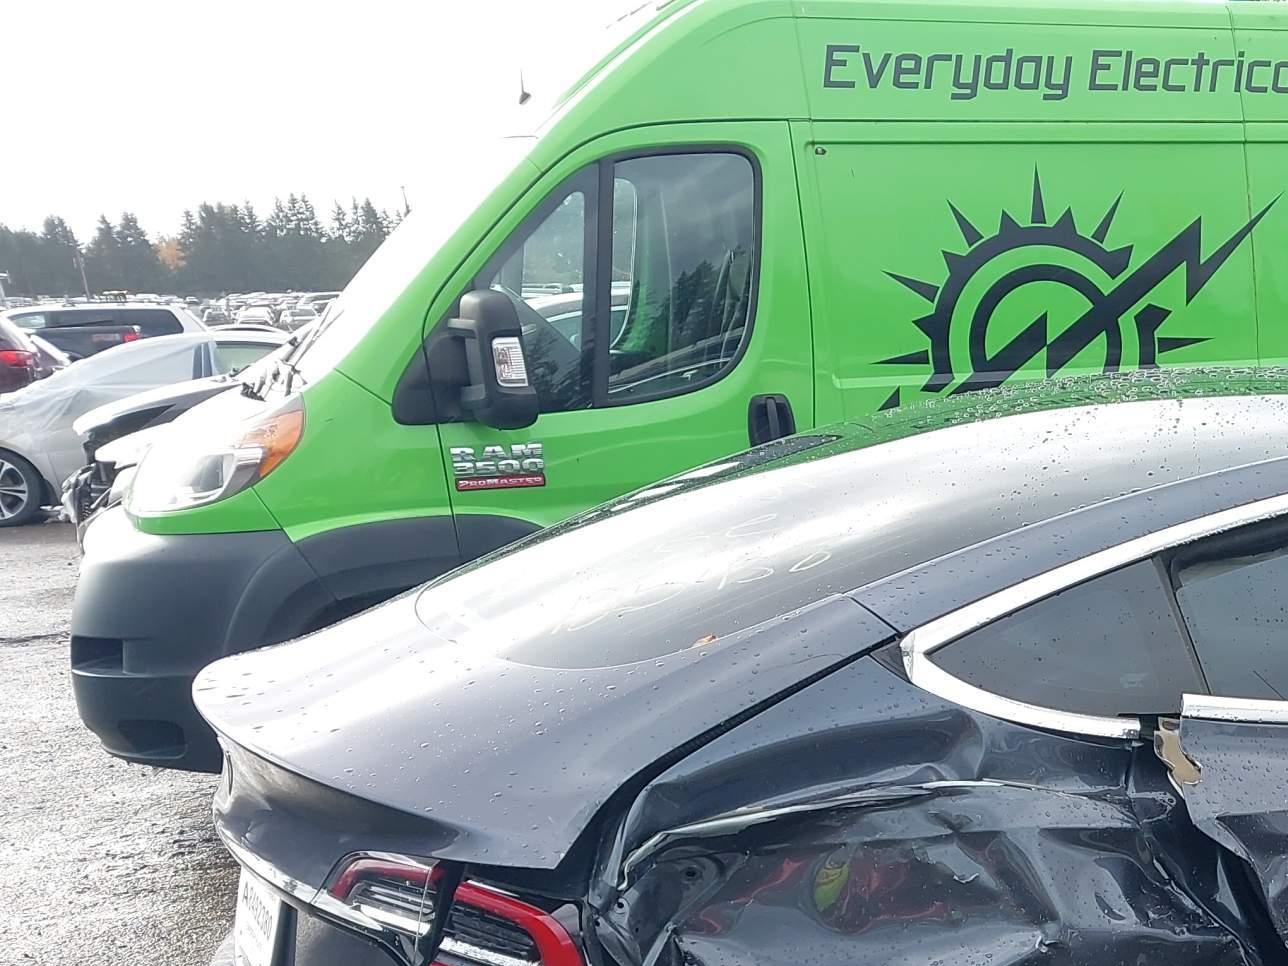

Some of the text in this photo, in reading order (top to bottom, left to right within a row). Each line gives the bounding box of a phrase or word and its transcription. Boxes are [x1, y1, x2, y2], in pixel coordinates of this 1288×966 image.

[823, 44, 1072, 101] Everyday
[450, 443, 542, 461] RAM
[453, 458, 544, 474] 3500
